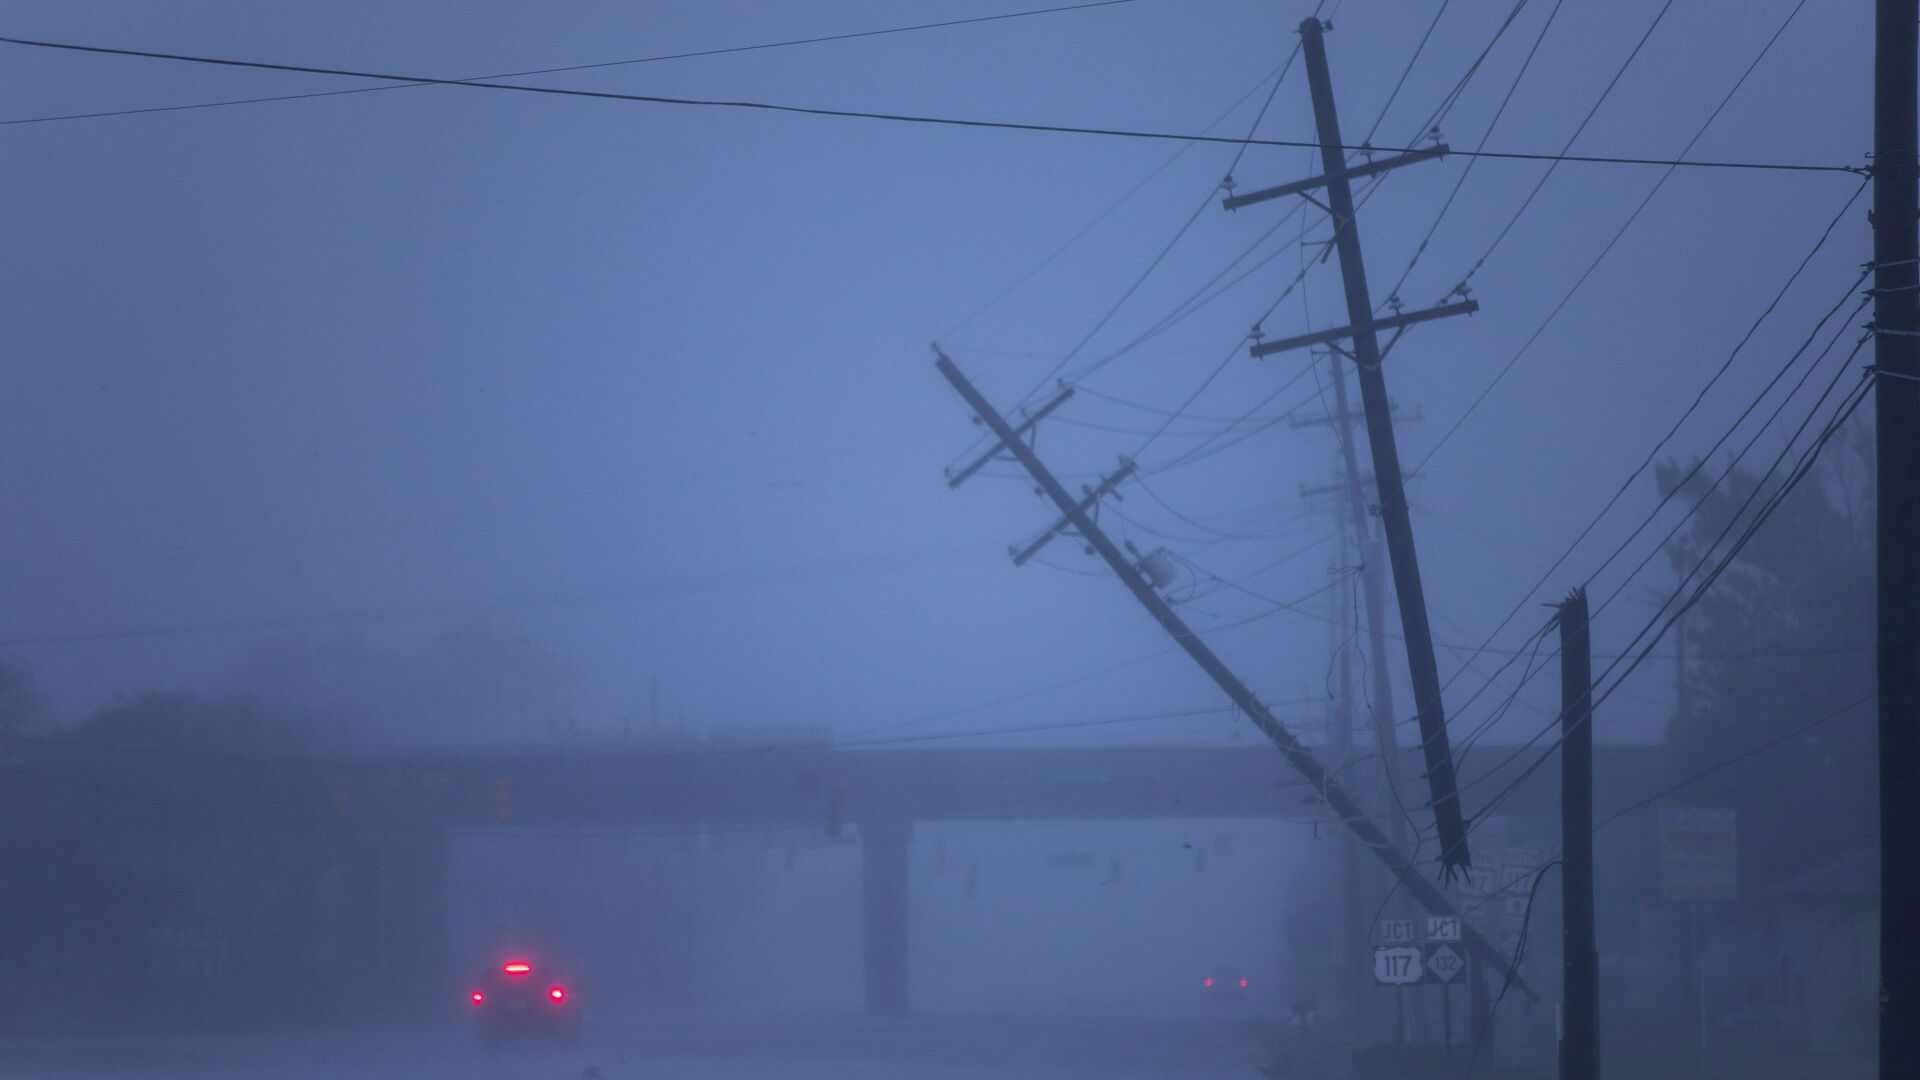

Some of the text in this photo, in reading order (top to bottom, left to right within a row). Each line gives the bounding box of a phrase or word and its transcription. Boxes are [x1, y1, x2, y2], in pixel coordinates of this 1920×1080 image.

[1382, 922, 1411, 939] JCT
[1430, 919, 1457, 937] JCT
[1384, 955, 1412, 977] 117
[1435, 955, 1457, 972] 132
